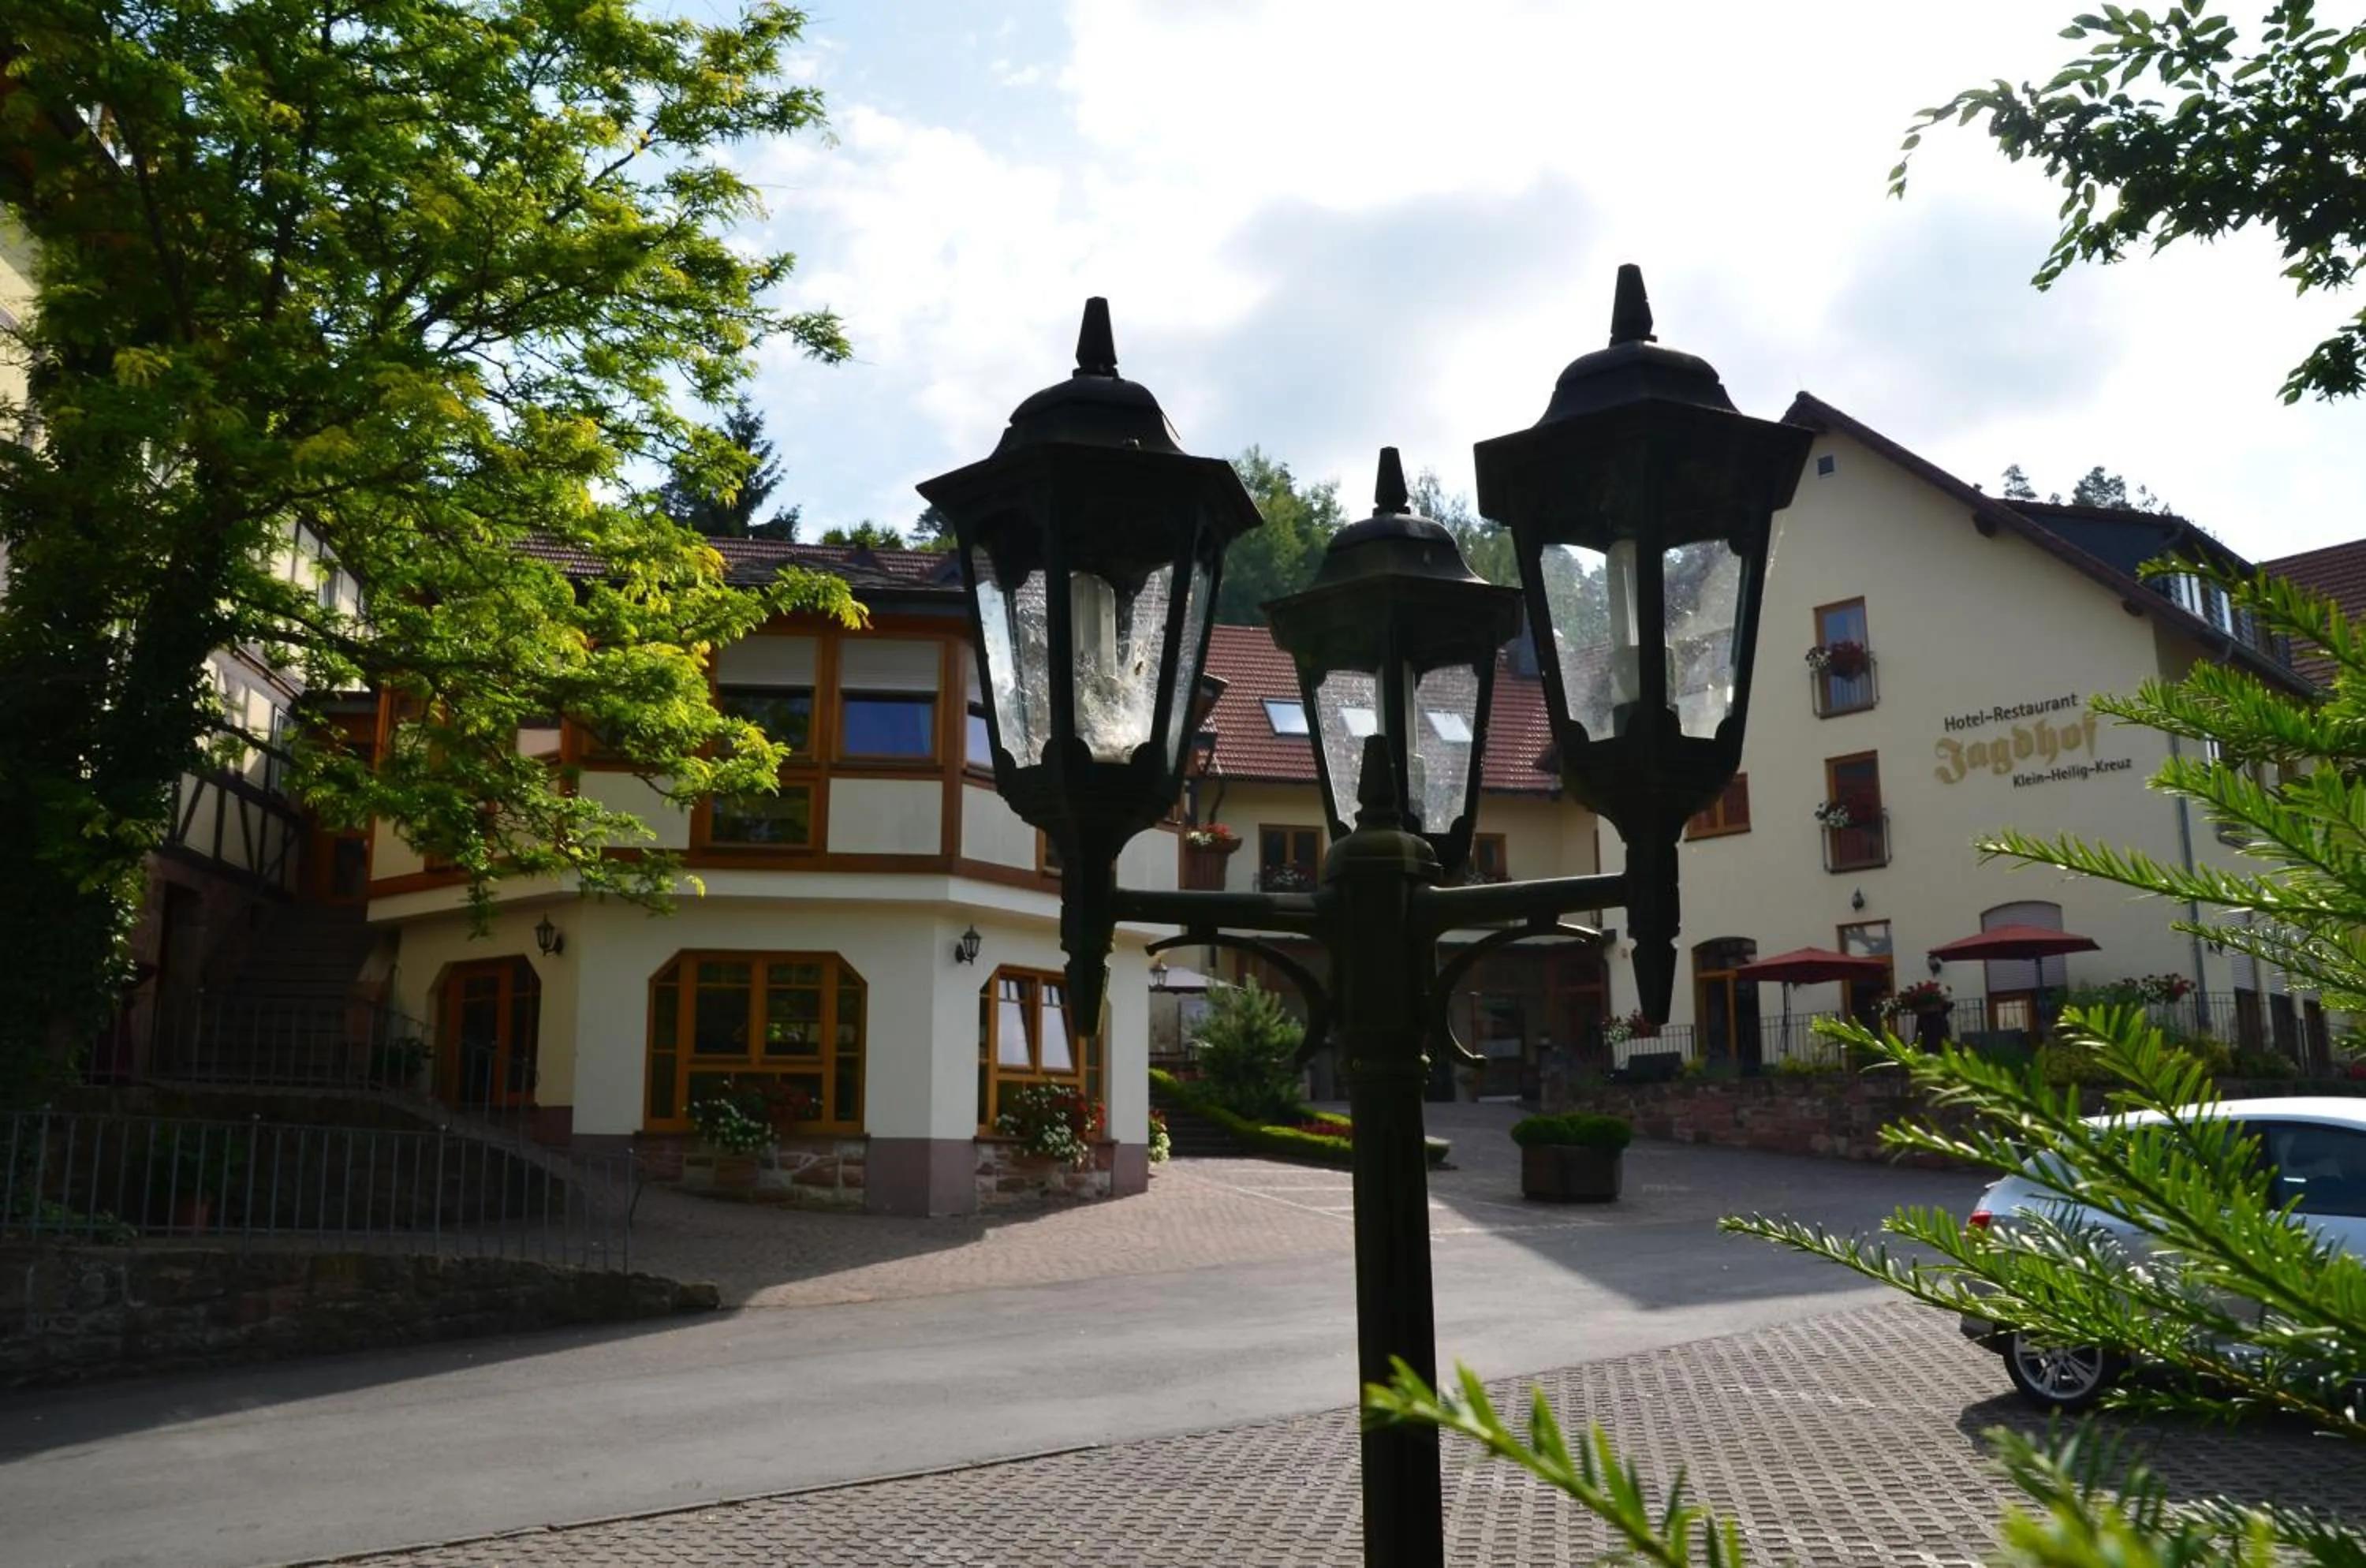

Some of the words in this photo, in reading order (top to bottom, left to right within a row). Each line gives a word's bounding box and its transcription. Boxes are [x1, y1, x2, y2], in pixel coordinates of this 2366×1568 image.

[1944, 693, 2078, 732] Hotel-Restaurant
[1935, 711, 2098, 785] Jagdhof
[2013, 757, 2133, 788] Klein-Heilig-Kreuz
